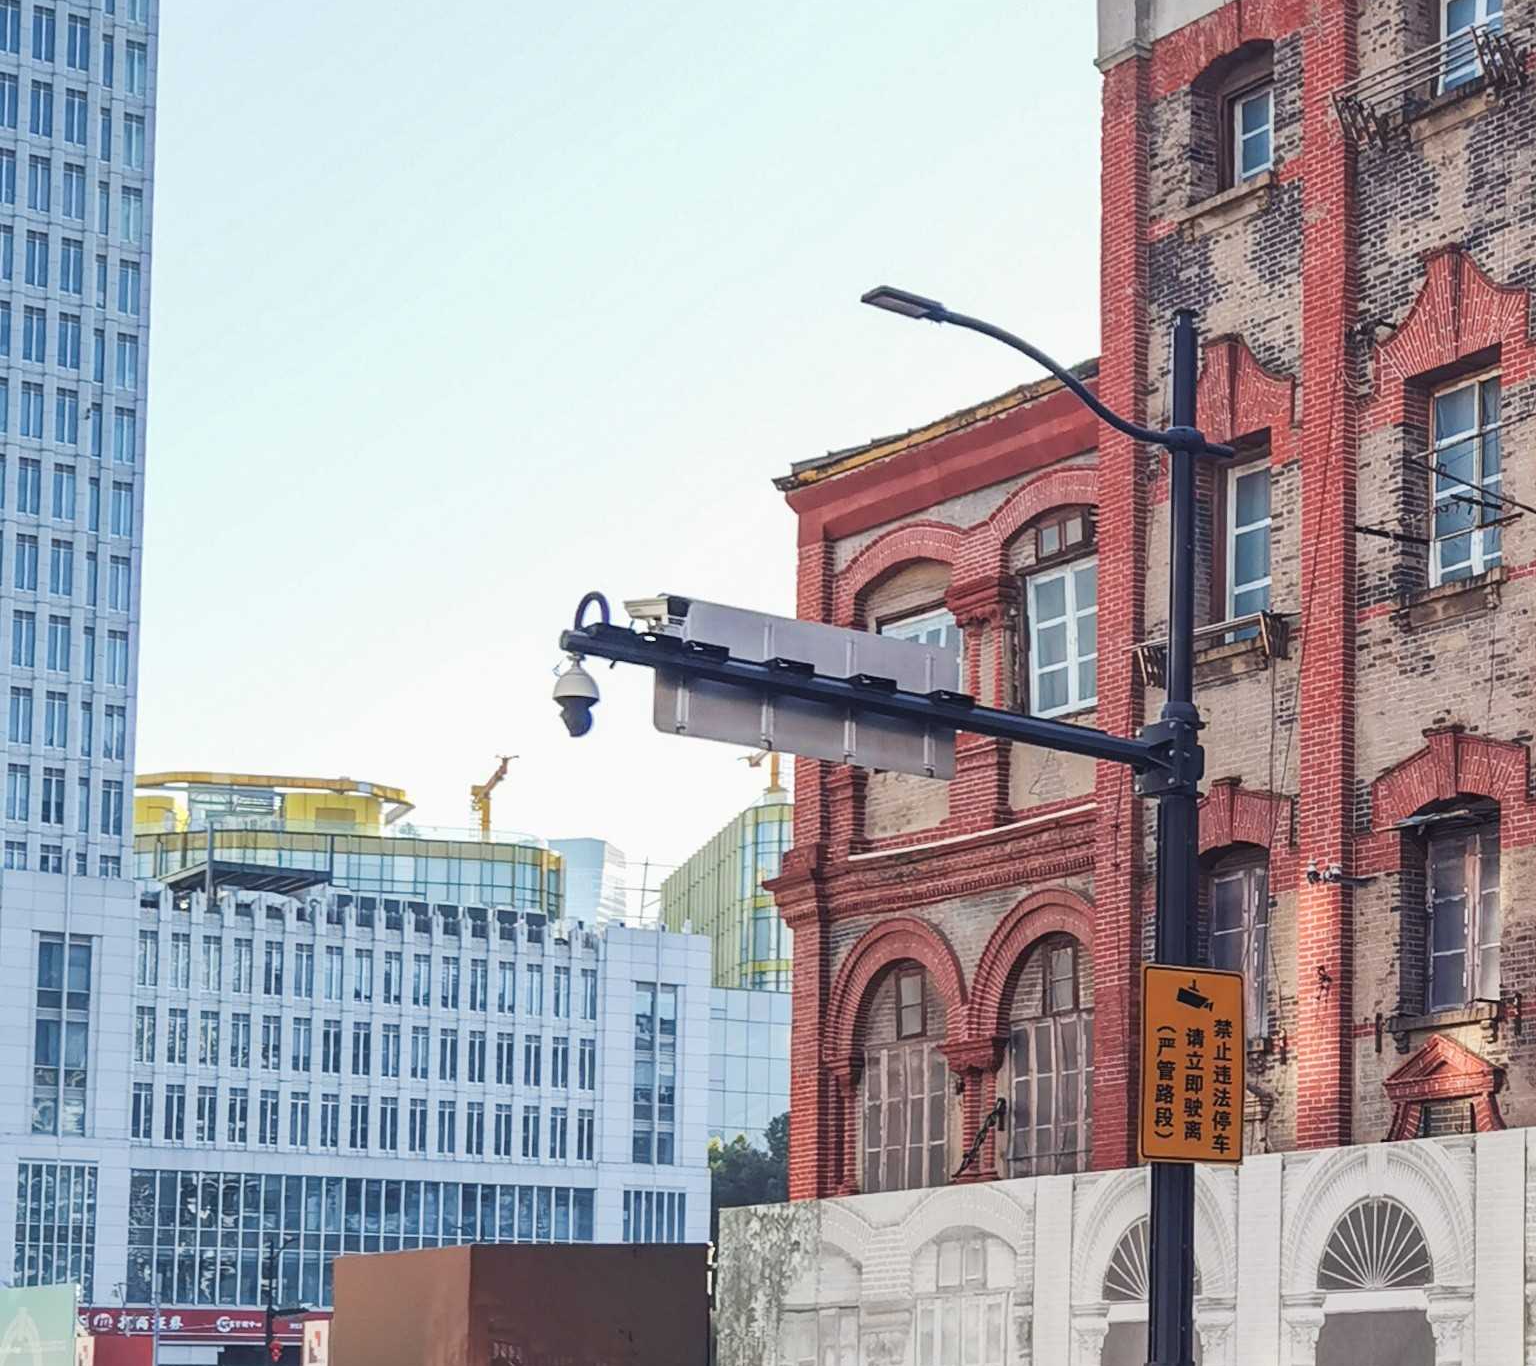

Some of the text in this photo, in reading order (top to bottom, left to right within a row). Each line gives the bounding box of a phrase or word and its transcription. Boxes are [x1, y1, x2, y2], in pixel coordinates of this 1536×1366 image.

[1184, 1027, 1204, 1142] 请立即驶离
[1212, 1018, 1233, 1154] 禁止违法停车
